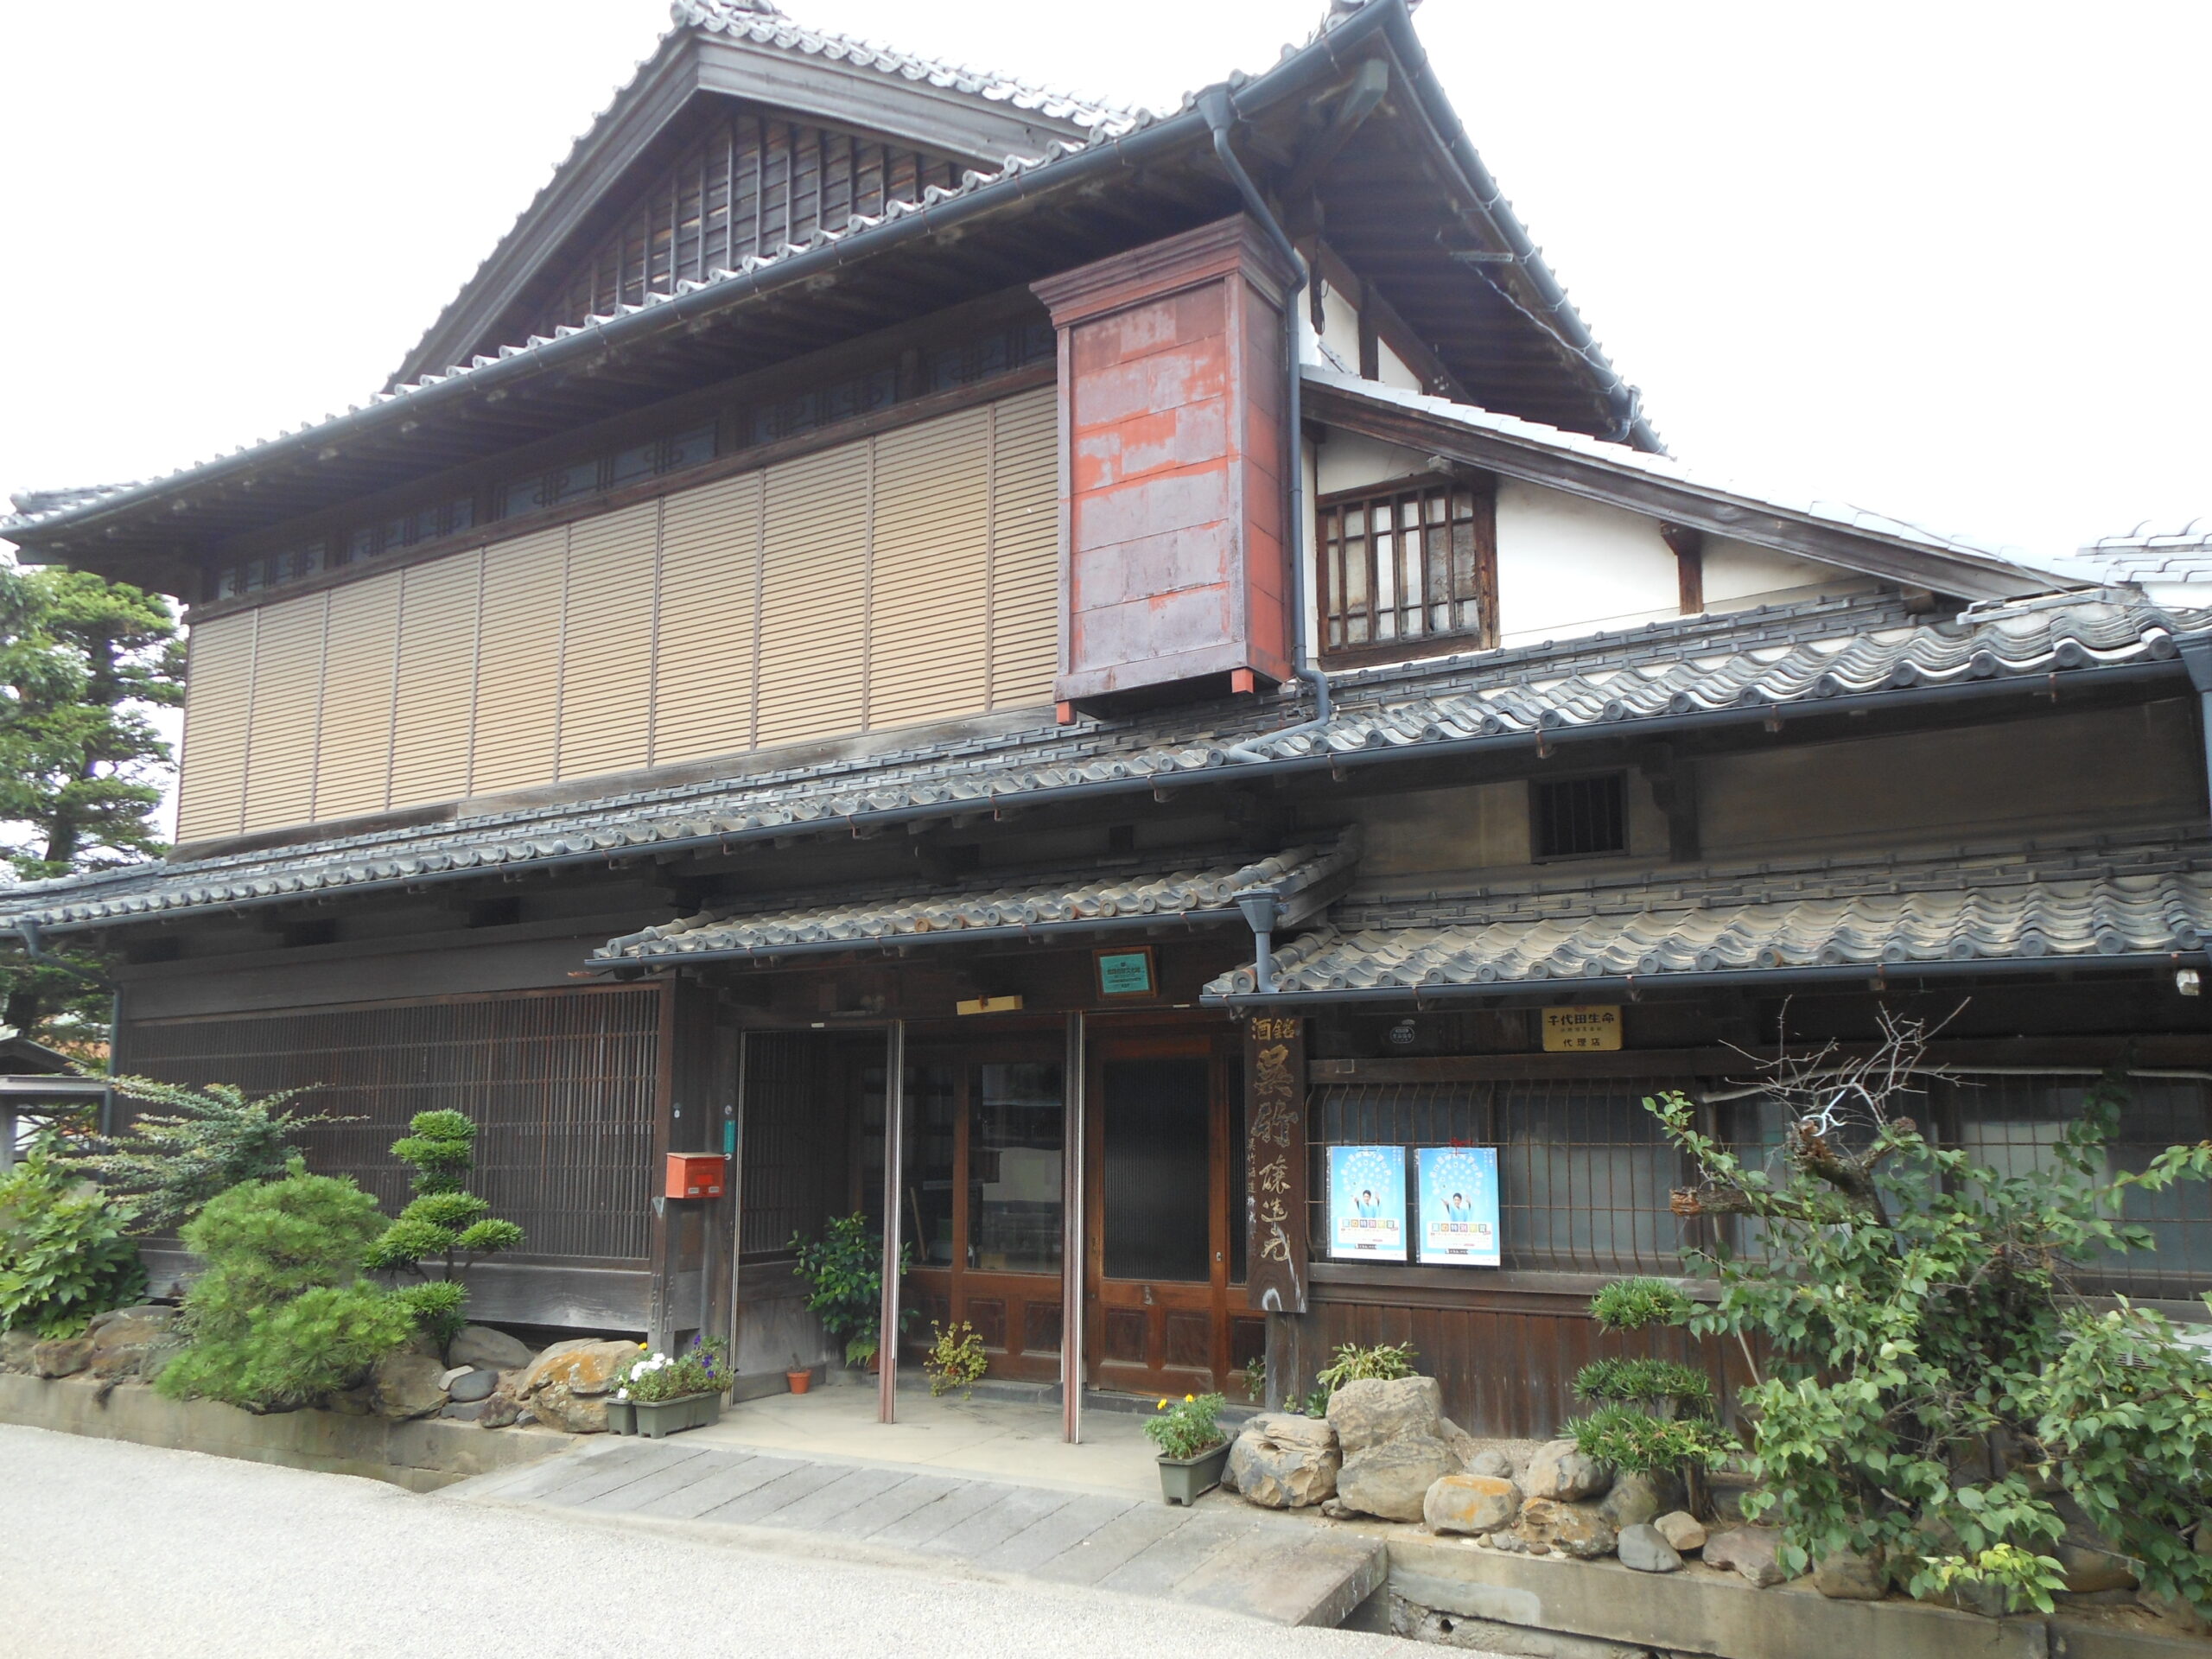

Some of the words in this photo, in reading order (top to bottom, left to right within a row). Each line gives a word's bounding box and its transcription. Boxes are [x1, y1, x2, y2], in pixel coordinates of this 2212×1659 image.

[1548, 1012, 1615, 1027] 千代田生命
[1562, 1037, 1601, 1048] 代理店
